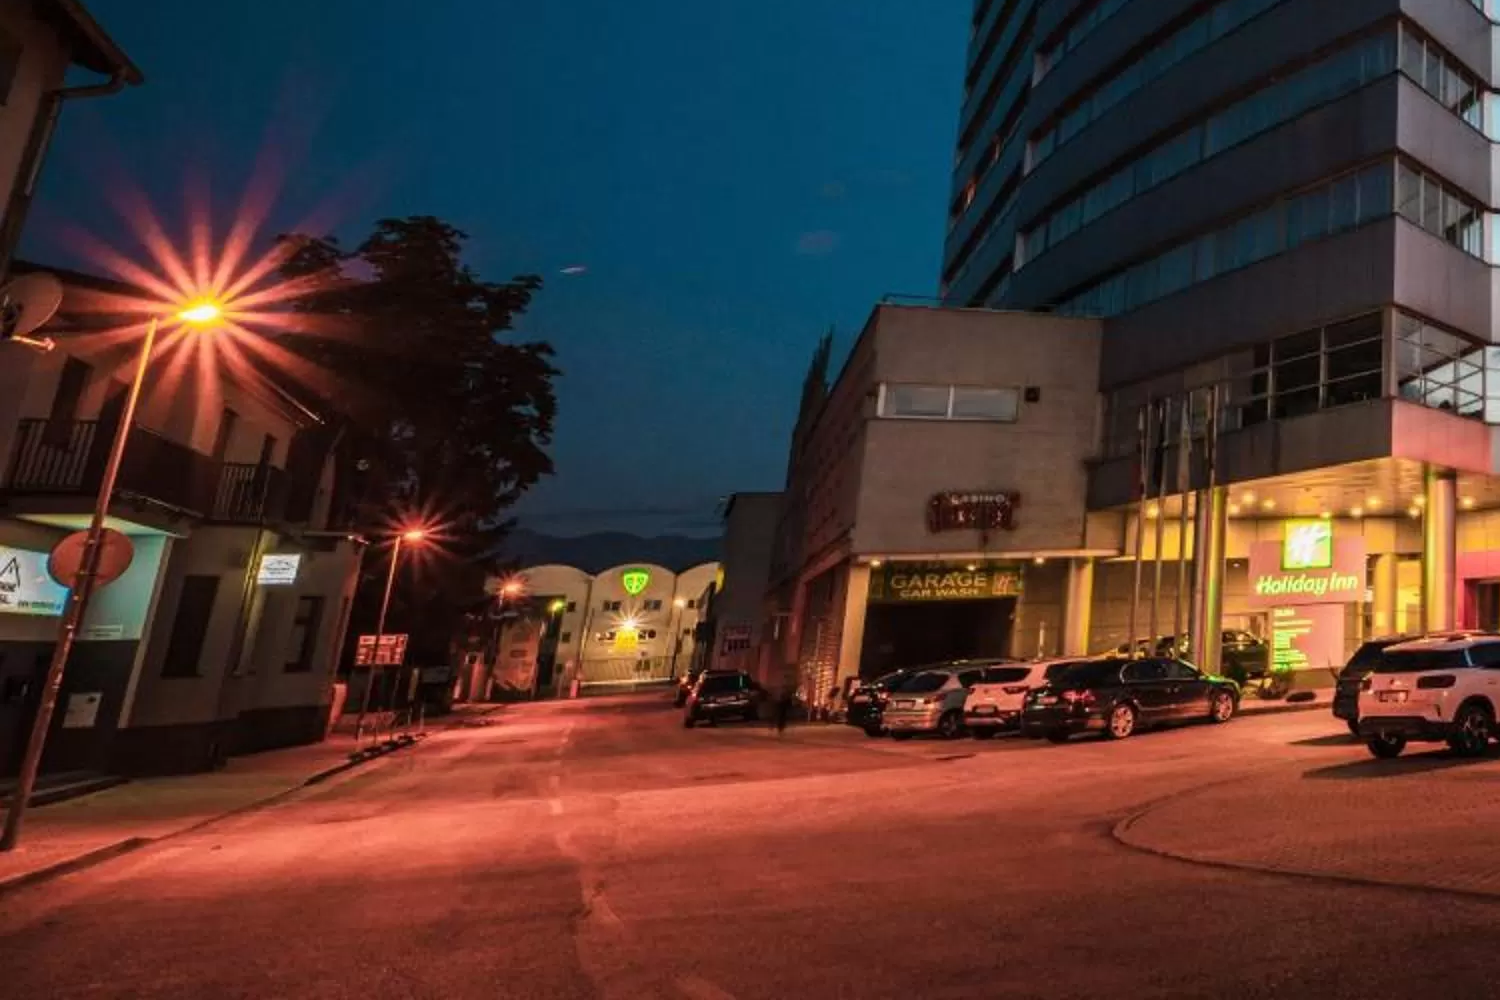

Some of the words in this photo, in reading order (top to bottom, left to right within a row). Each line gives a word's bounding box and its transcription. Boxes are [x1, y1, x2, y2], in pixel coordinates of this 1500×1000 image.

[890, 572, 988, 589] GARAGE
[1256, 573, 1328, 595] Holiday
[1329, 572, 1358, 591] Inn
[900, 588, 931, 598] CAR
[935, 587, 978, 597] WASH
